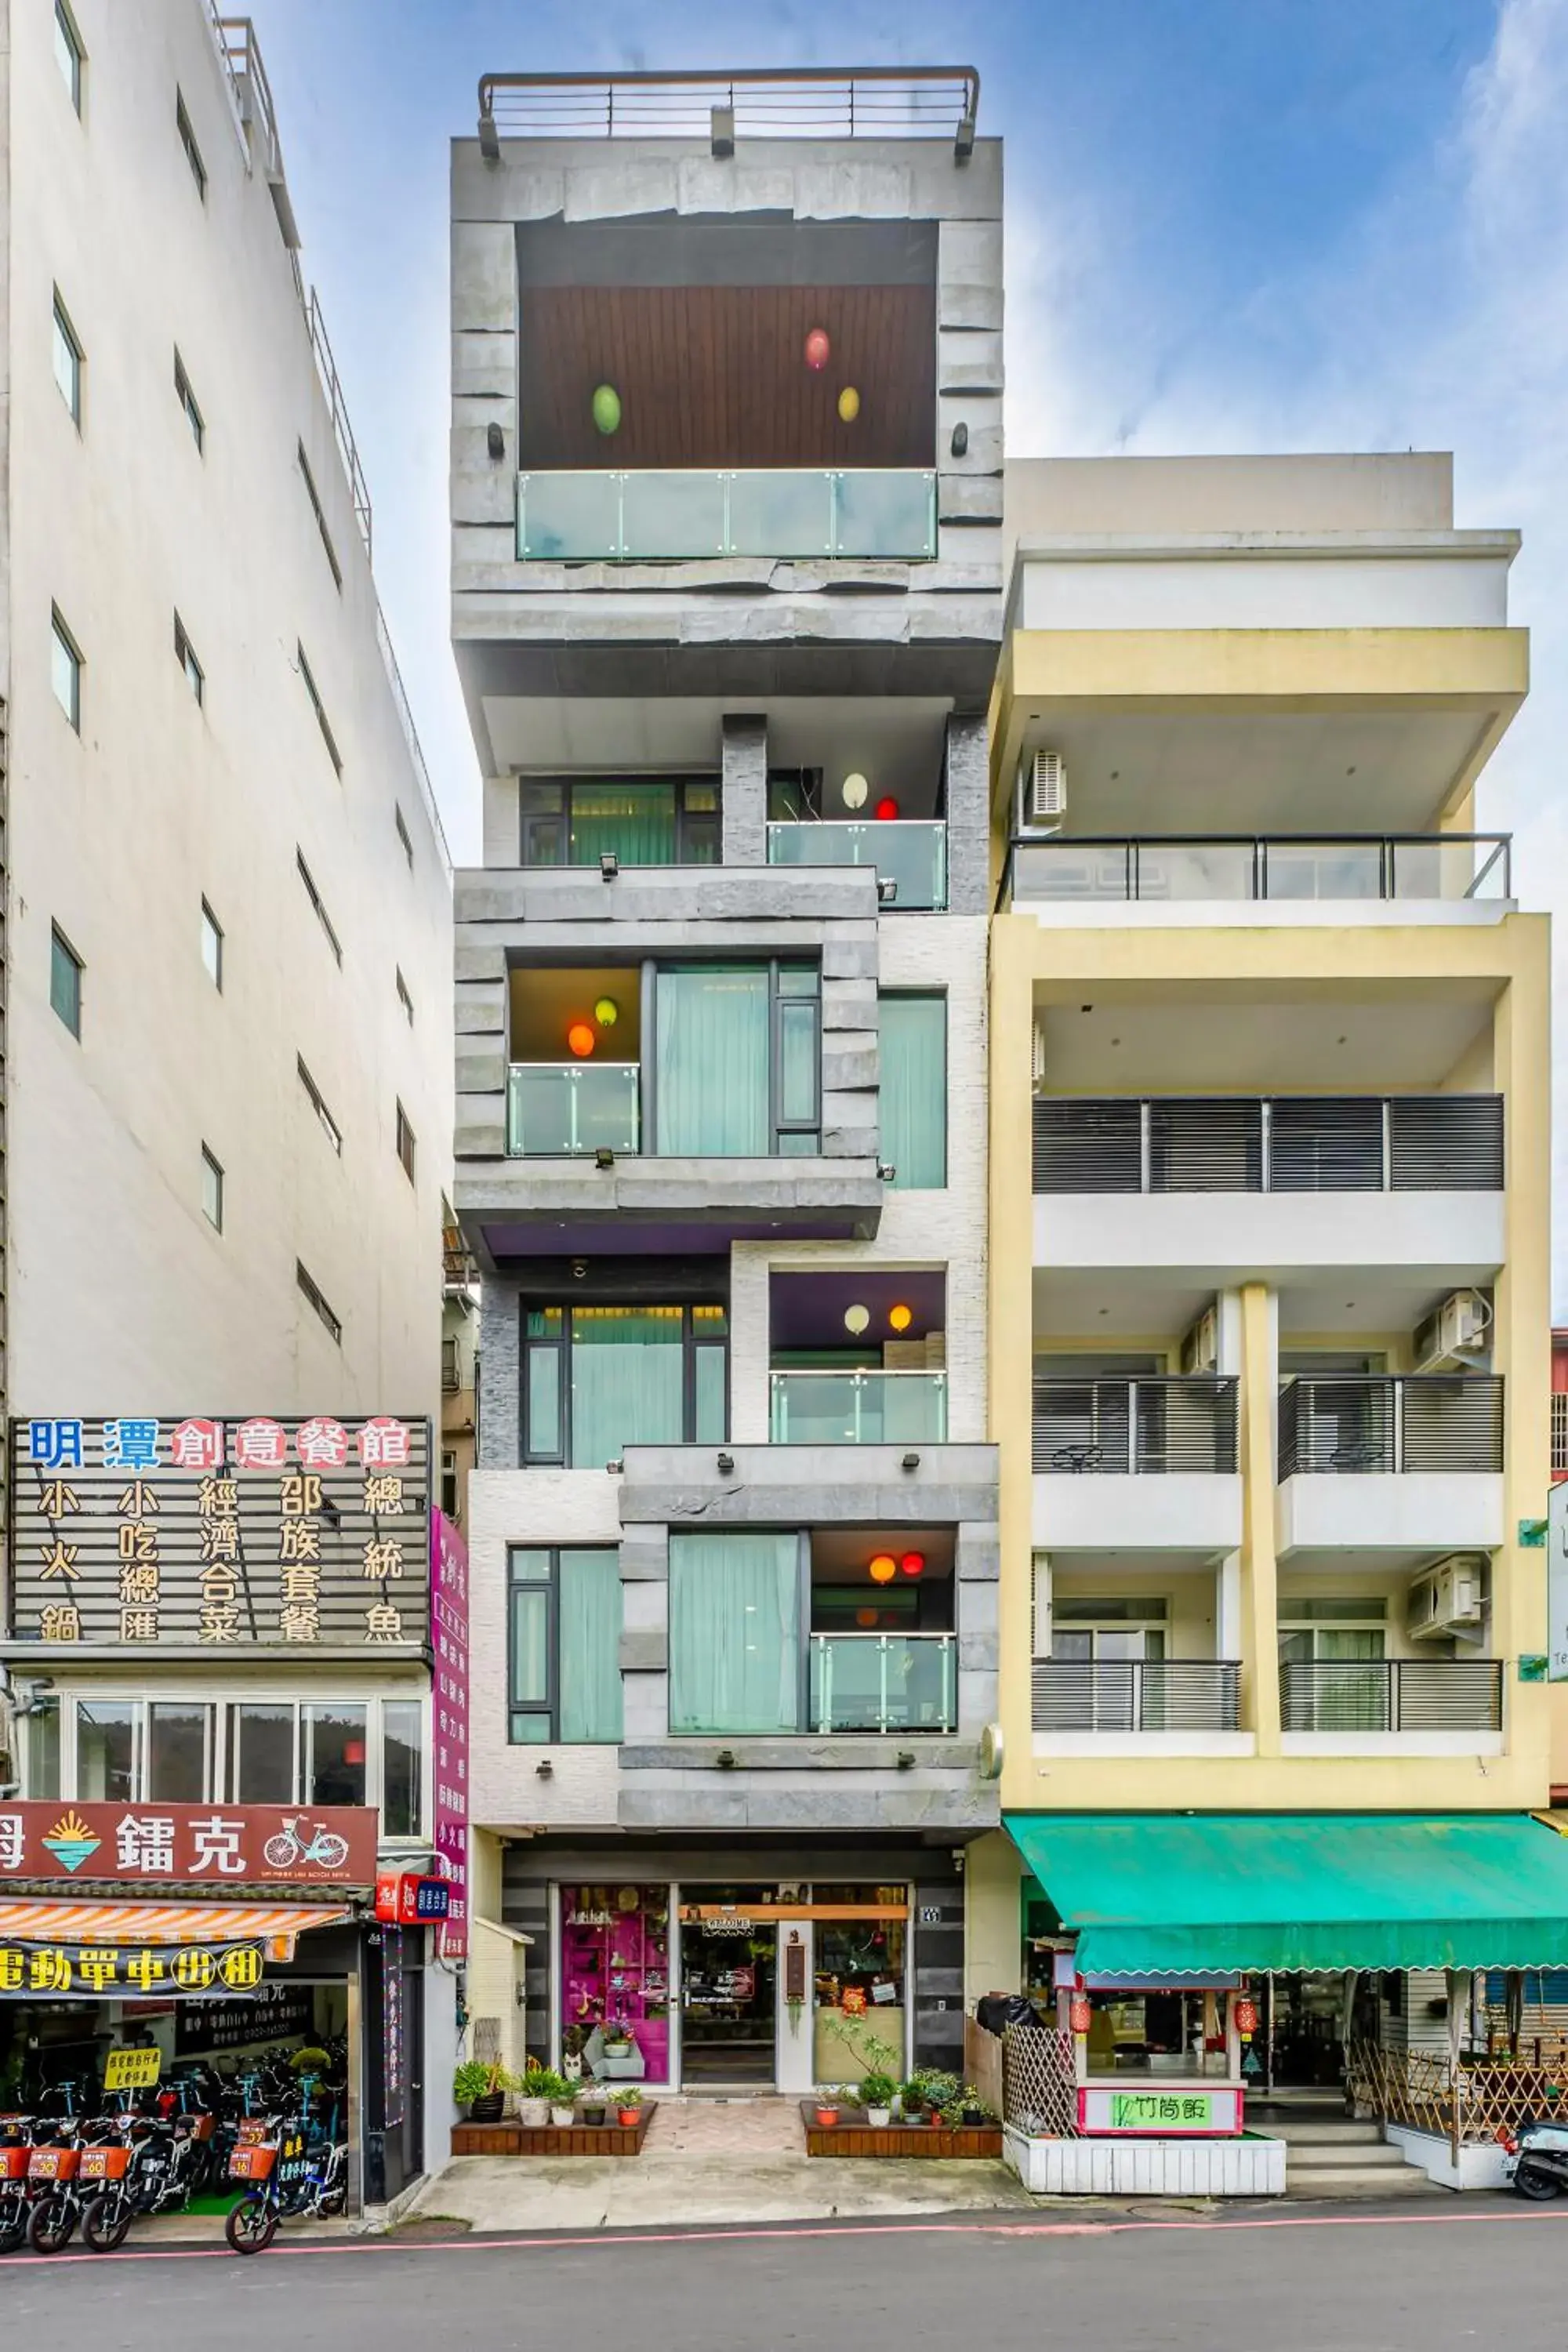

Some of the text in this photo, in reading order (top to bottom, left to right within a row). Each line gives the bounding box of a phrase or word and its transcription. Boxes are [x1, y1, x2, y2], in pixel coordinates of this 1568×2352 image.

[28, 1417, 410, 1469] 明潭創意餐館
[38, 1479, 81, 1640] 小火鍋
[117, 1480, 159, 1640] 小吃總匯
[198, 1475, 240, 1642] 經濟合菜
[279, 1475, 323, 1642] 邵族套餐
[362, 1475, 405, 1640] 總統魚
[708, 1918, 750, 1929] WELCOME
